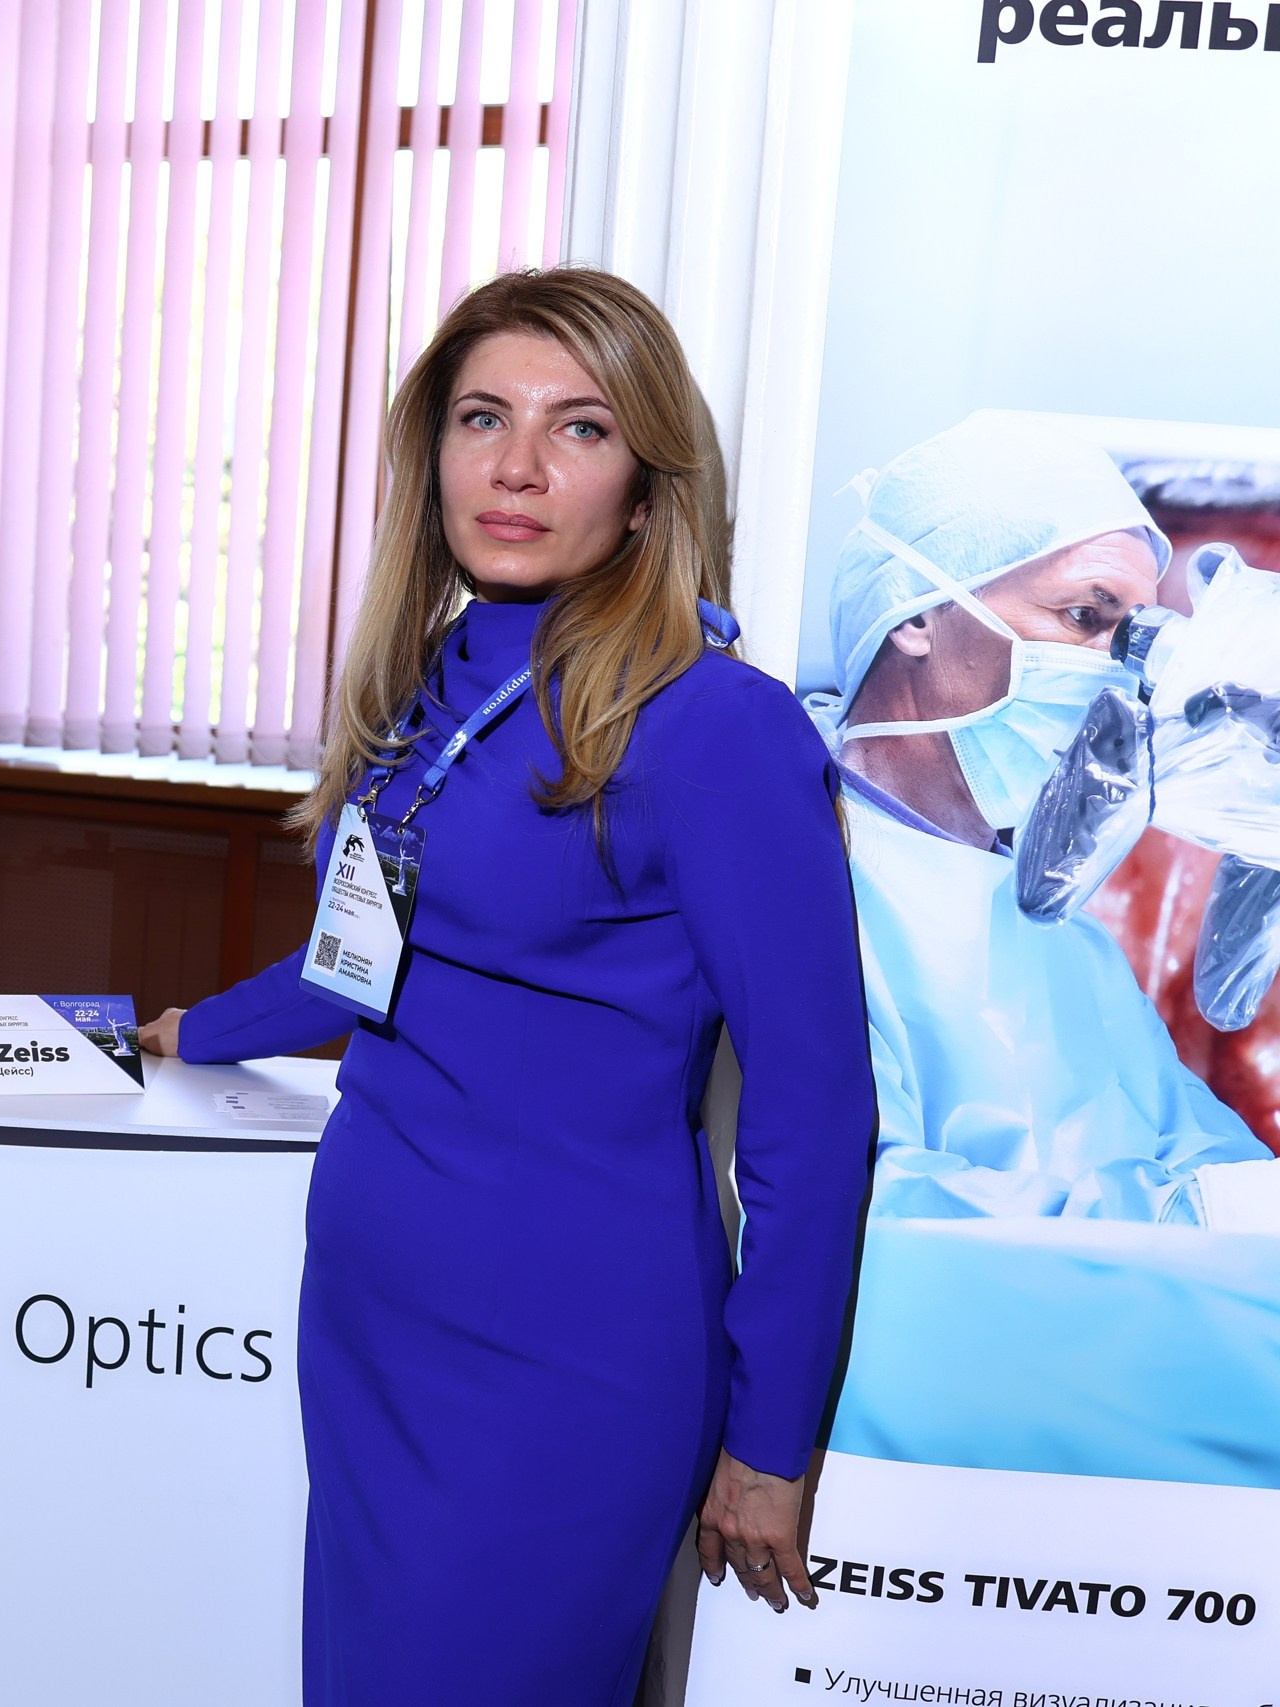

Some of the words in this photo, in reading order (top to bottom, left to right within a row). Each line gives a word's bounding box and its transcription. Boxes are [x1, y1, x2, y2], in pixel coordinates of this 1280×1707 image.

[977, 0, 1280, 63] реаль
[1130, 626, 1145, 644] 10x
[482, 668, 532, 715] хирургов
[335, 861, 356, 881] XII
[328, 900, 344, 912] 22-24
[340, 958, 369, 975] КРИСТИНА
[343, 949, 373, 967] МЕЛКОНЯН
[338, 967, 372, 986] АМАЯКОВНА
[15, 1293, 274, 1389] Optics
[808, 1554, 945, 1603] ZEISS
[964, 1574, 1147, 1618] TIVATO
[1166, 1588, 1257, 1627] 700
[825, 1667, 1003, 1707] Улучшенная
